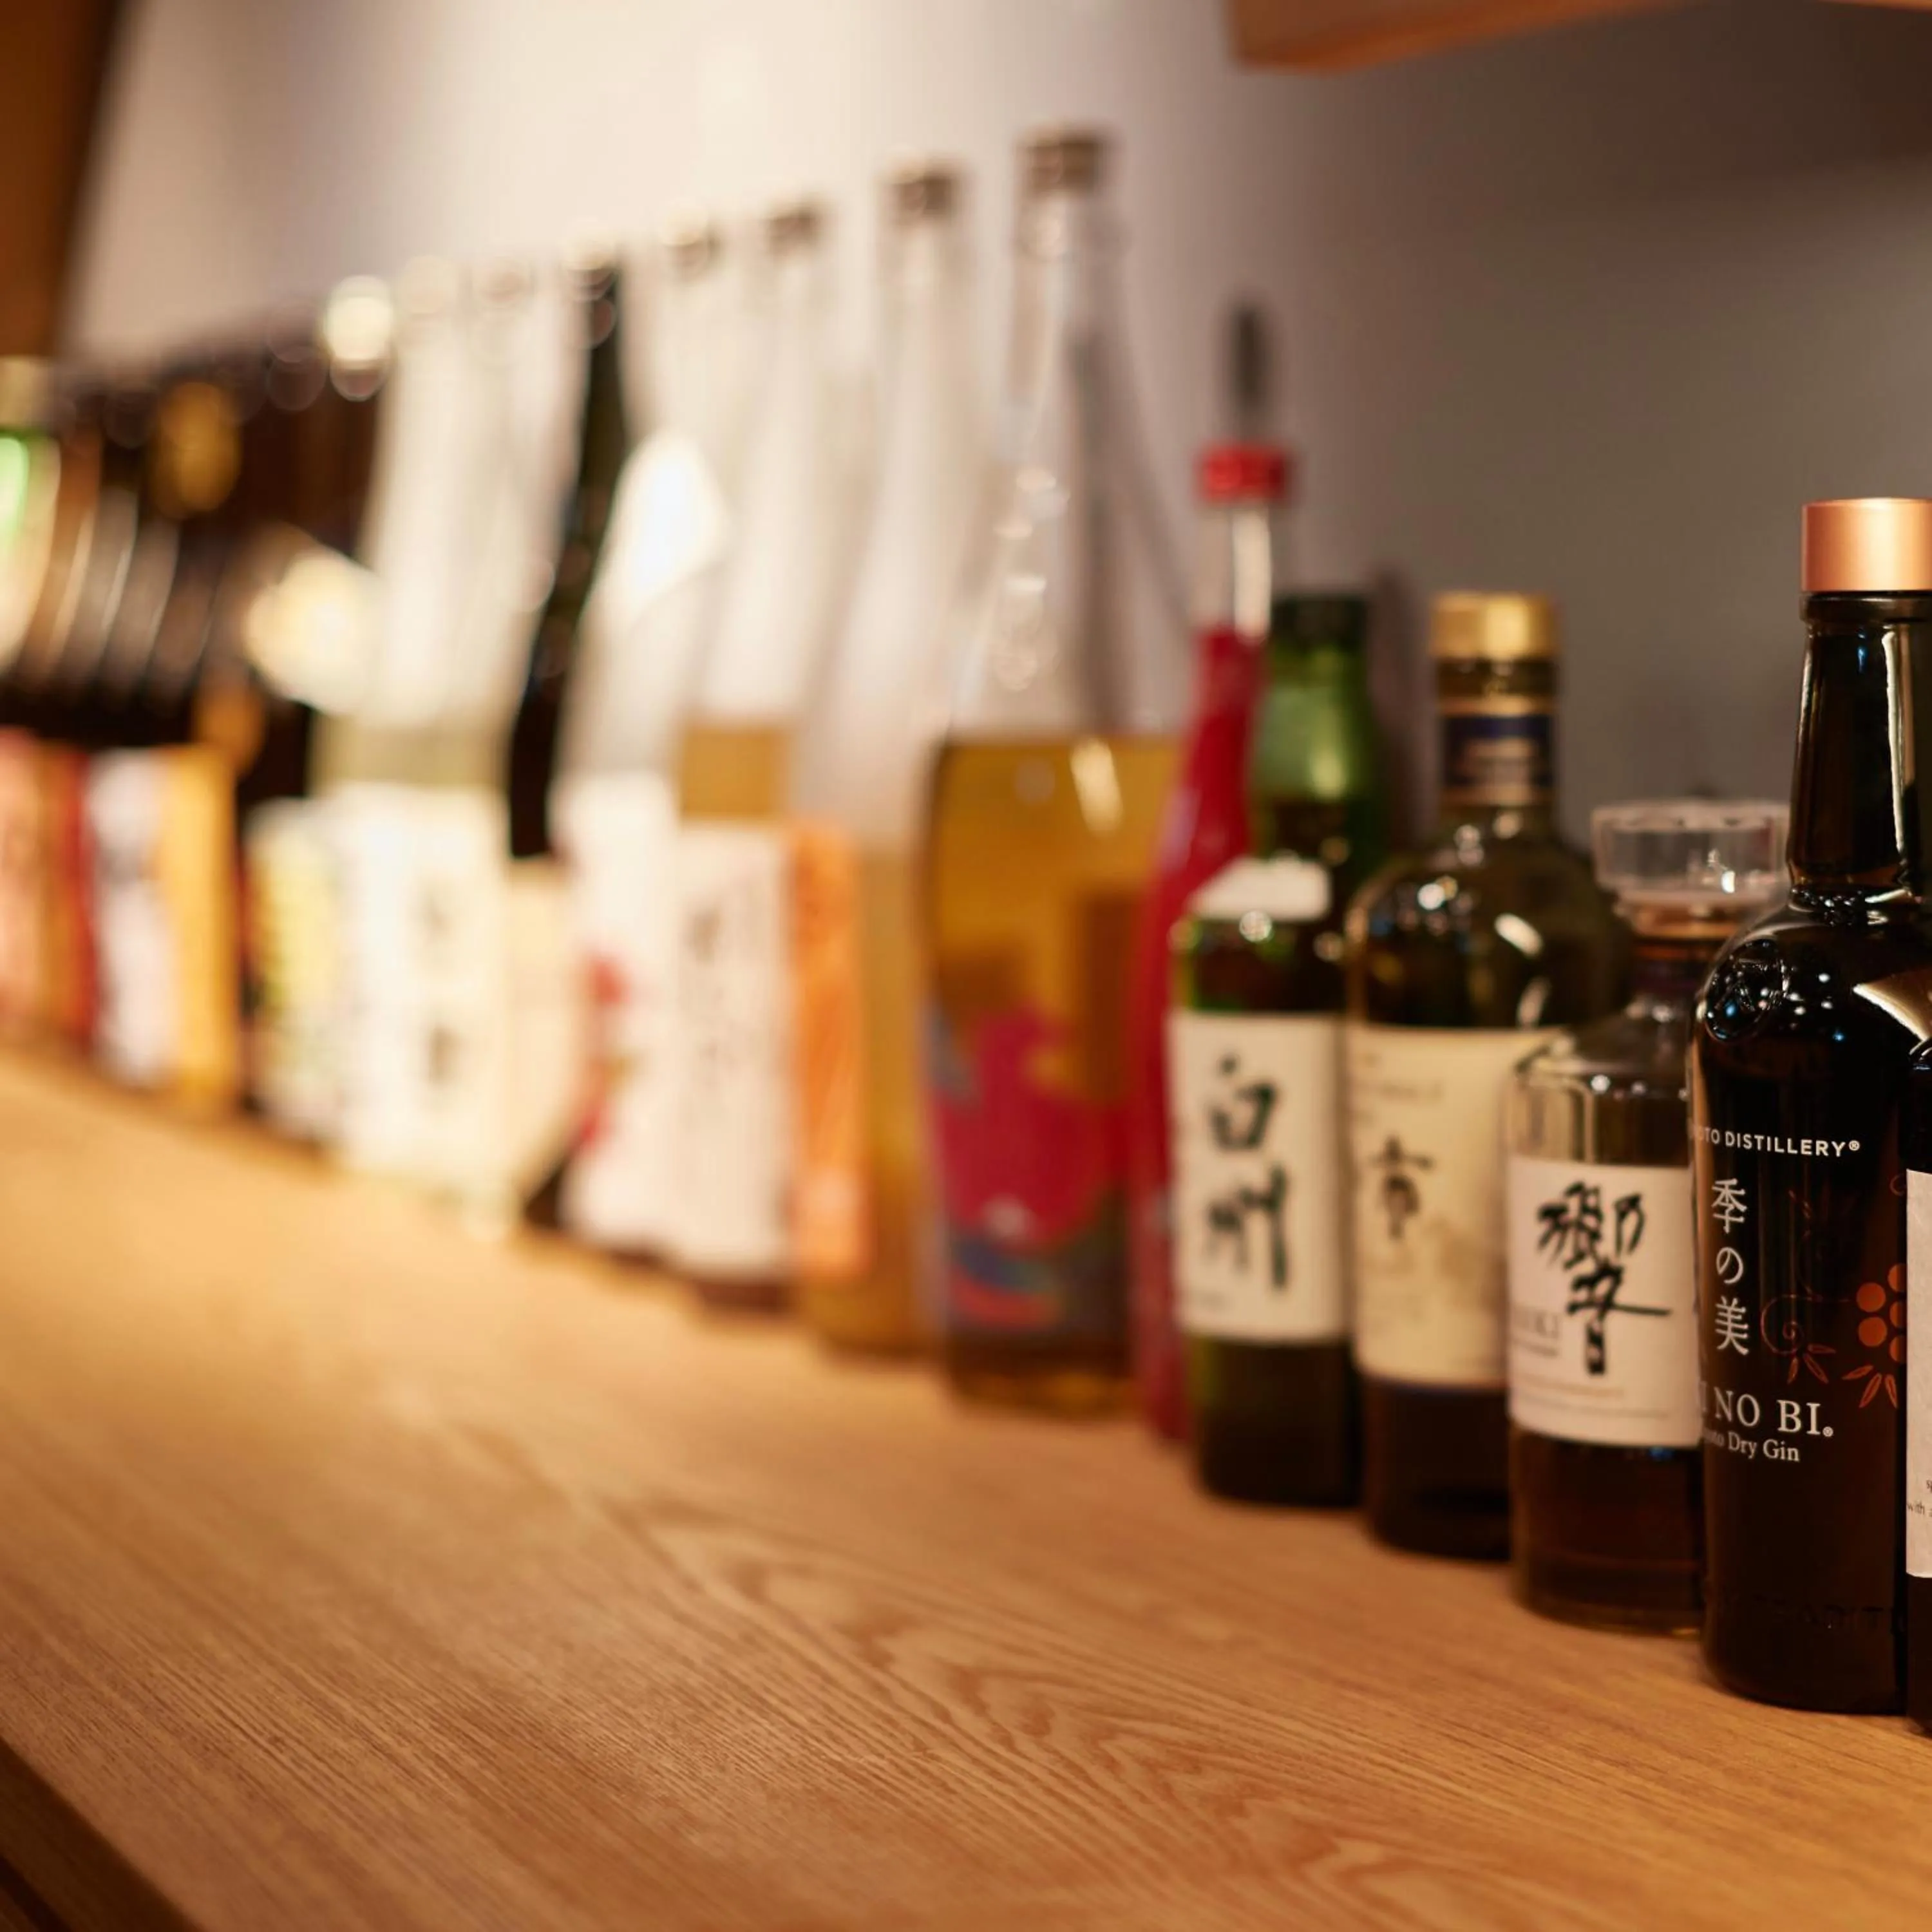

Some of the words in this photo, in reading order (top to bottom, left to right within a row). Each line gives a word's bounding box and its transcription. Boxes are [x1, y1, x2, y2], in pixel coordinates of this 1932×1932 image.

[1712, 1178, 1749, 1356] 季の美
[1714, 1386, 1760, 1427] NO
[1728, 1431, 1757, 1459] Dry
[1763, 1439, 1800, 1463] Gin
